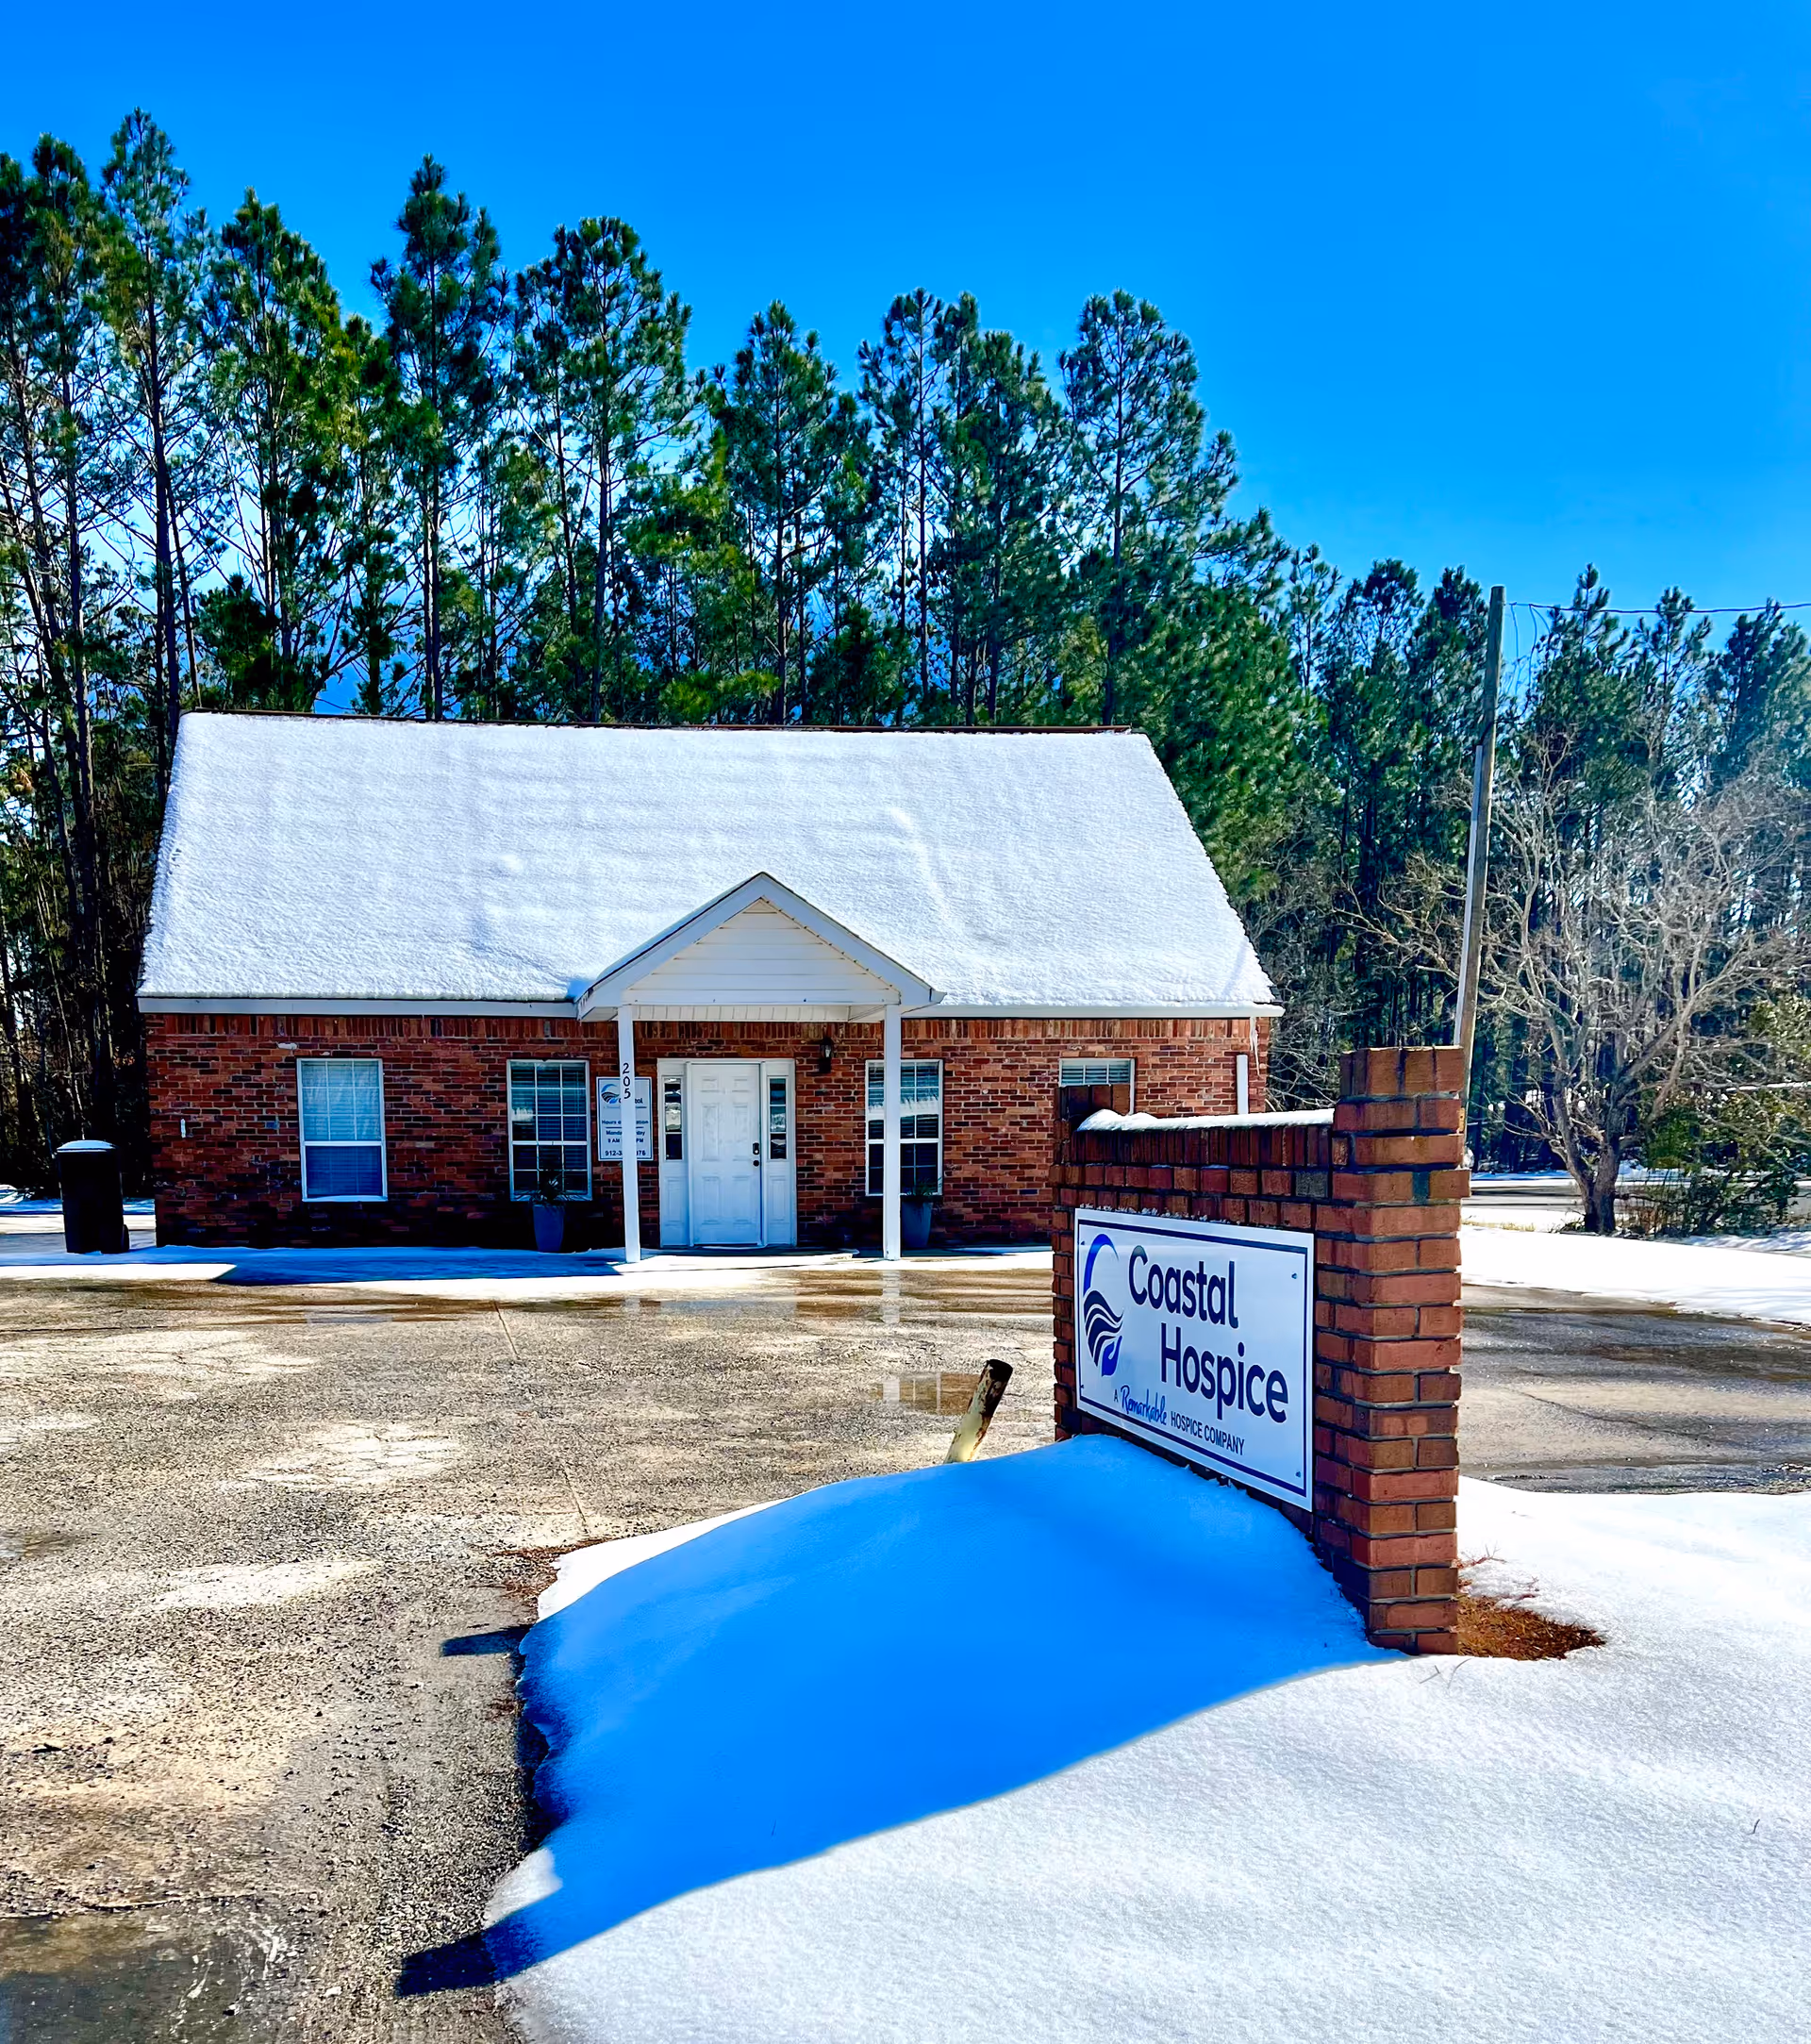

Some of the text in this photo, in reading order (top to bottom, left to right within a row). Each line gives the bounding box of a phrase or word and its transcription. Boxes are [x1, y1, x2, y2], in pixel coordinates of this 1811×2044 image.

[623, 1063, 631, 1099] 205
[1129, 1245, 1238, 1328] Coastal
[1161, 1322, 1288, 1422] Hospice
[1114, 1385, 1245, 1455] A Remarkable HOSPICE COMPANY
